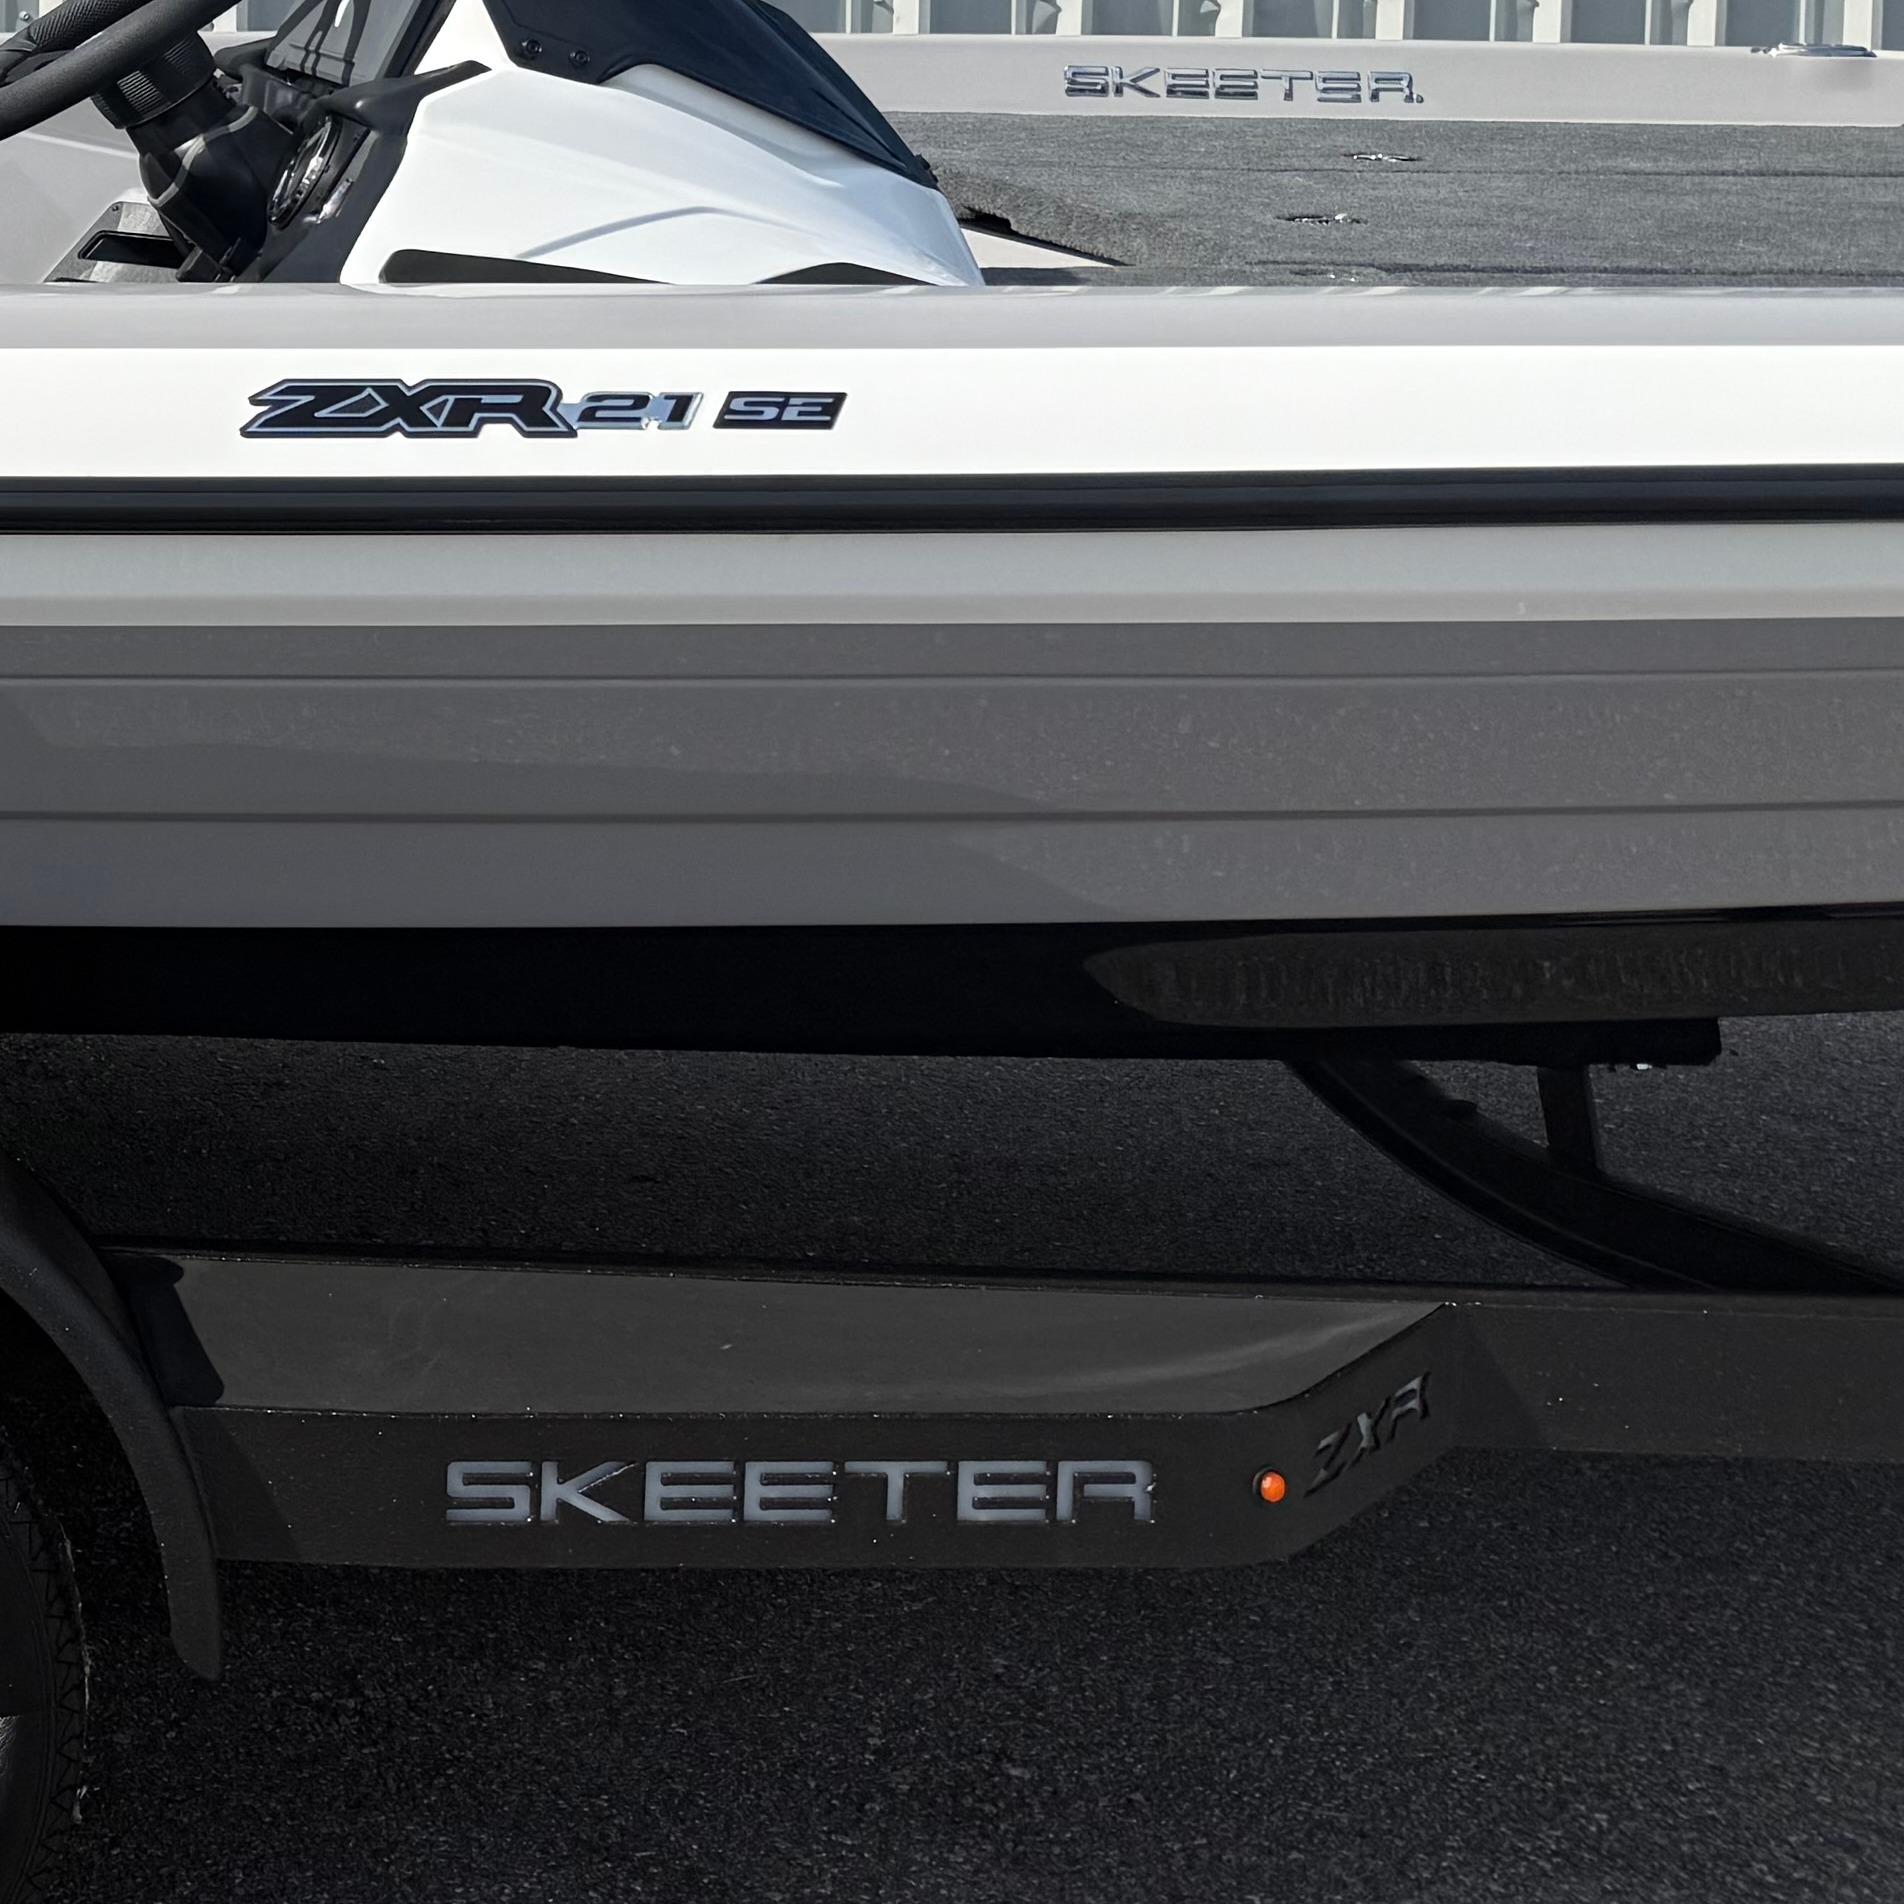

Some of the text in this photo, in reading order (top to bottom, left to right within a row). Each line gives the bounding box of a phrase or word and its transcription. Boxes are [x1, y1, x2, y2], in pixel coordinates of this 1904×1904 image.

[1064, 65, 1416, 104] SKEETER
[239, 378, 842, 439] ZXR 21 SE
[446, 1460, 1157, 1524] SKEETER
